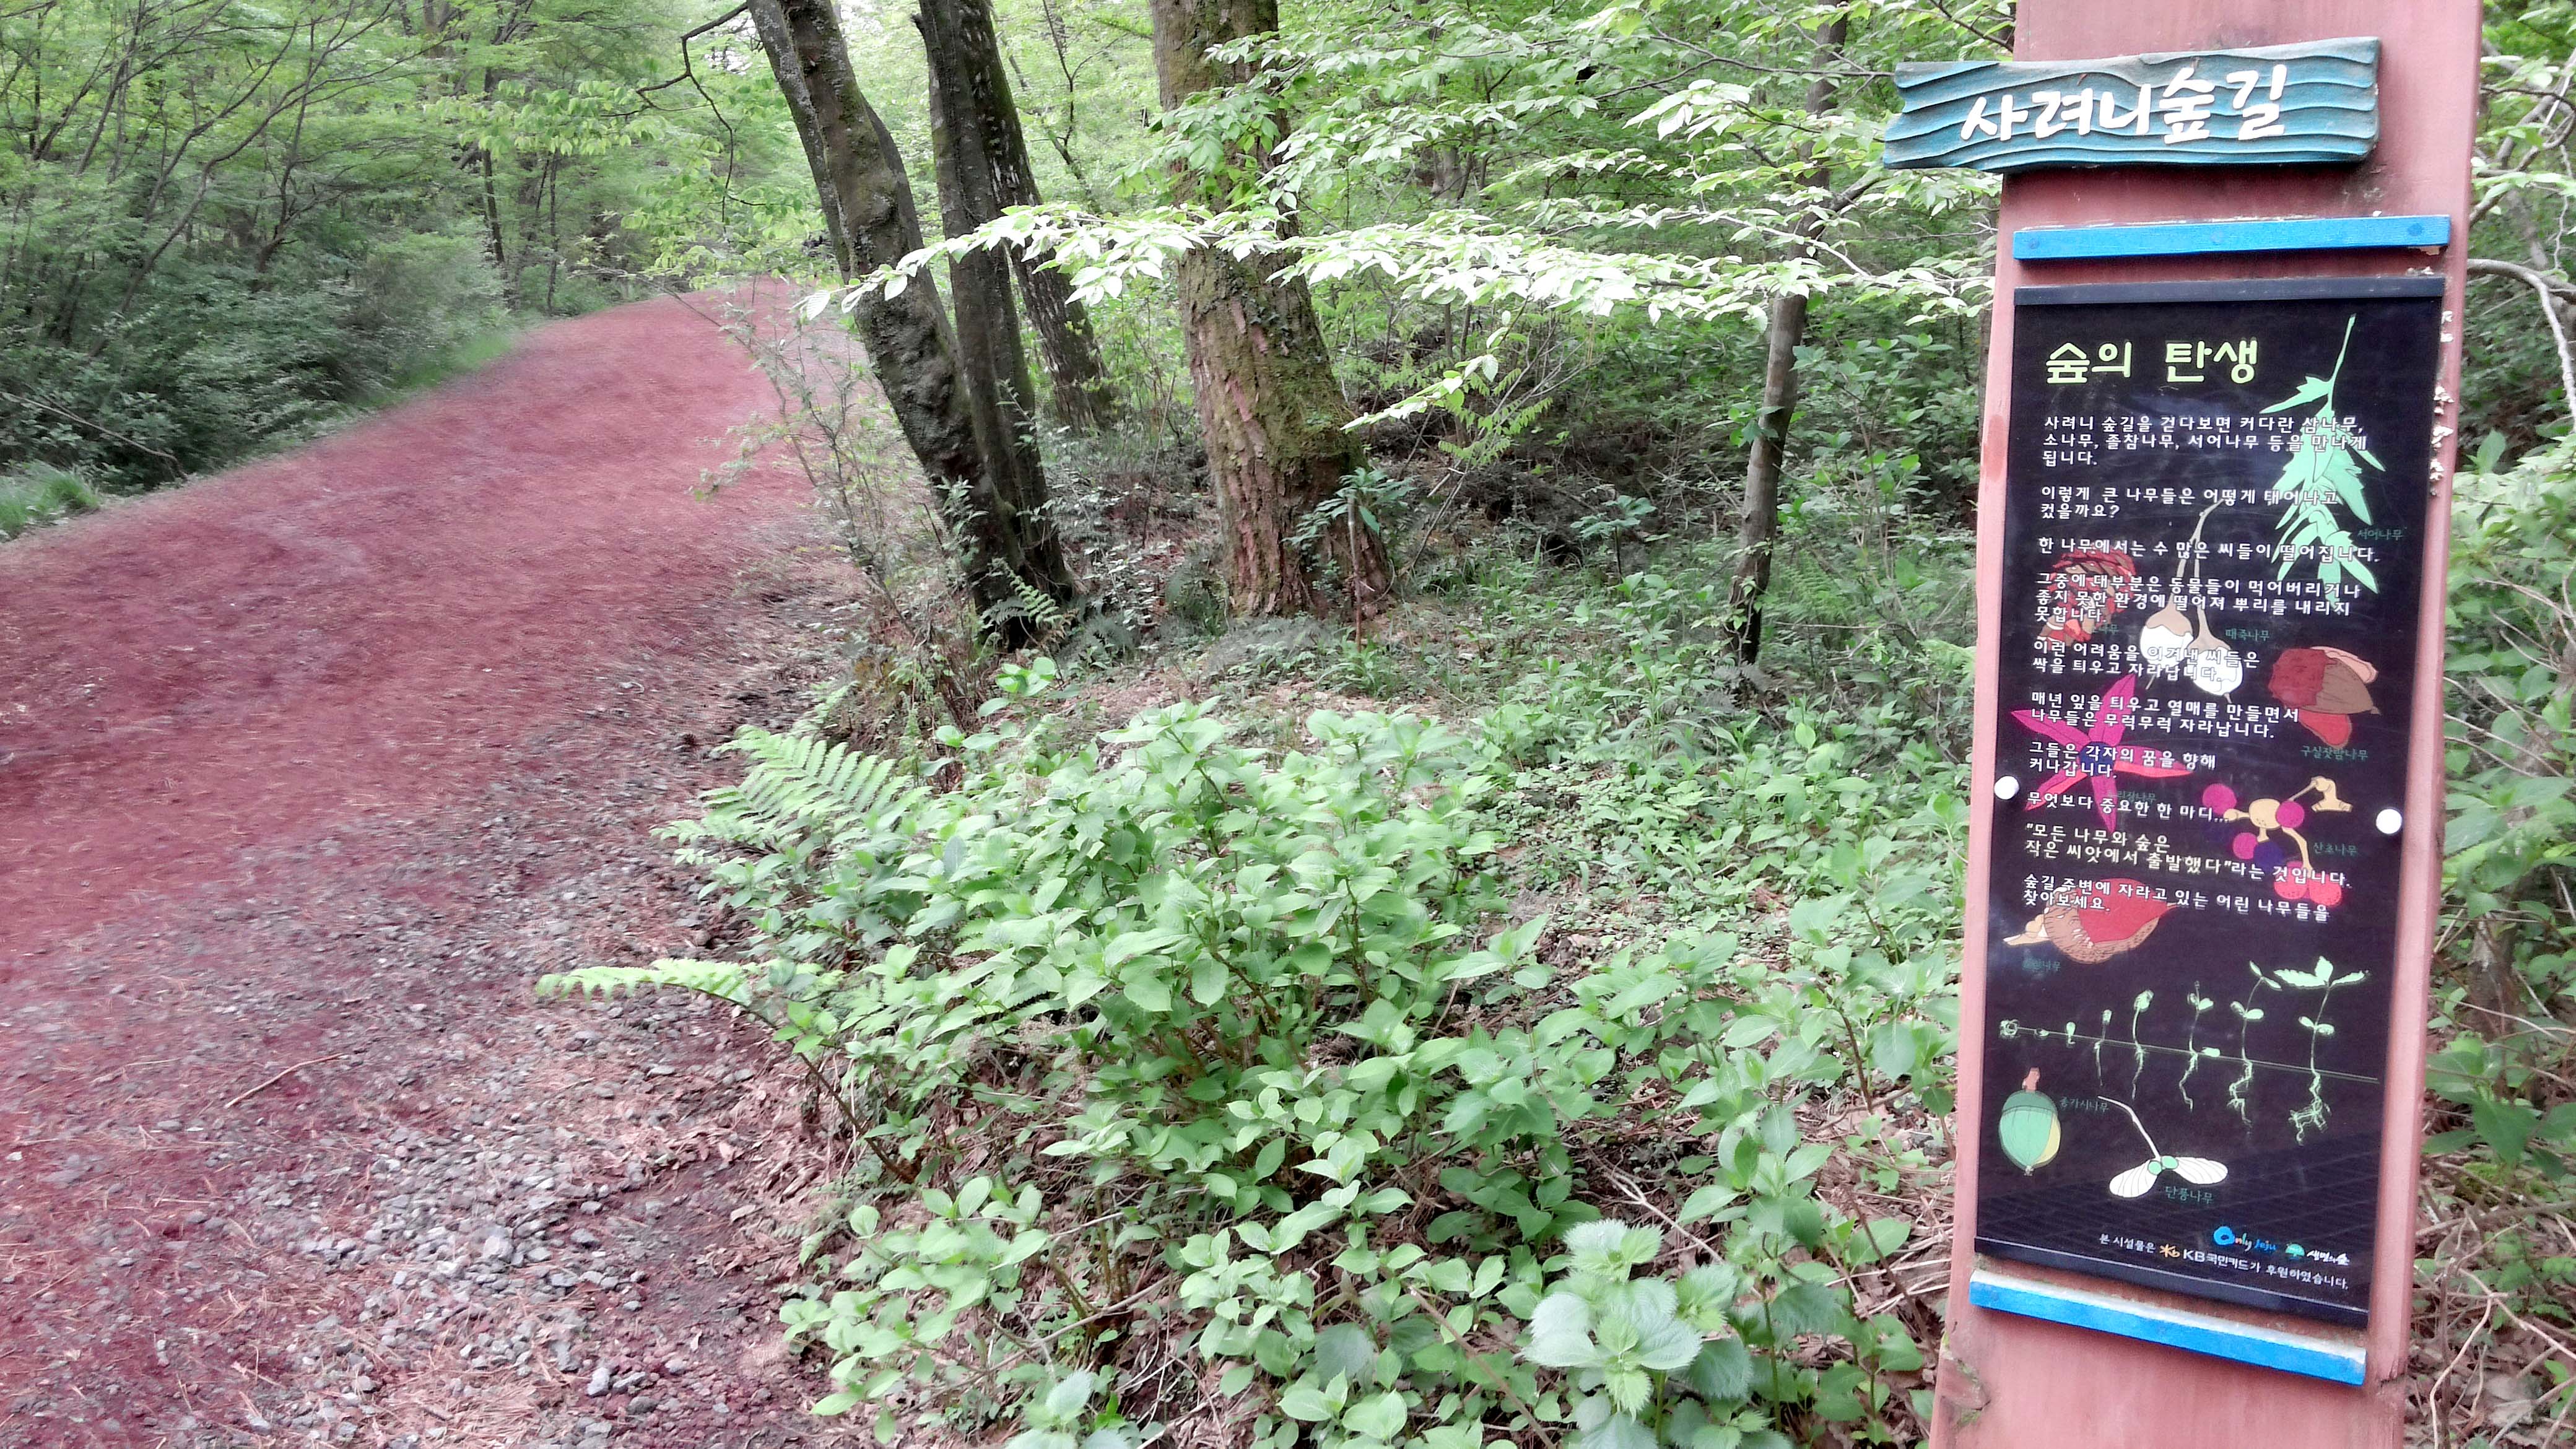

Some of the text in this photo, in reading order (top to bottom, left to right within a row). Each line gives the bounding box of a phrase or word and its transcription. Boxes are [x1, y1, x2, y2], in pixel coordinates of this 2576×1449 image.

[1960, 64, 2288, 145] 사려니숲길
[2045, 339, 2258, 384] 숲의 탄생
[2044, 416, 2364, 434] 사려니 숲길을 걷다보면 커다란 삼나무,
[2043, 433, 2367, 453] 소나무, 졸참나무, 서어나무 등을 만나게
[2042, 450, 2098, 467] 됩니다.
[2041, 486, 2338, 506] 이렇게 큰 나무들은 어떻게 태어나고
[2041, 503, 2120, 520] 컸을까요?
[2357, 528, 2404, 541] 서어나무
[2039, 537, 2380, 564] 한 나무에서는 수 많은 씨들이 떨어집니다.
[2035, 573, 2361, 599] 그중에 대부분은 동물들이 먹어버리거나
[2034, 606, 2106, 623] 못합니다.
[2035, 589, 2351, 617] 좋지 못한 환경에 떨어져 뿌리를 내리지
[2033, 640, 2261, 669] 이런 어려움을 이겨낸 씨들은
[2032, 658, 2222, 682] 싹을 틔우고 자라납니다.
[2031, 692, 2300, 723] 매년 잎을 틔우고 열매를 만들면서
[2031, 708, 2274, 739] 나무들은 무럭무럭 자라납니다.
[2029, 741, 2217, 770] 그들은 각자의 꿈을 향해
[2029, 758, 2118, 778] 커나갑니다.
[2027, 791, 2094, 809] 무엇보다
[2100, 798, 2150, 817] 중요한
[2157, 802, 2172, 820] 한
[2074, 827, 2129, 846] 나무와
[2135, 833, 2170, 853] 숲은
[2026, 839, 2060, 859] 작은
[2066, 842, 2139, 866] 씨앗에서
[2272, 866, 2351, 888] 것입니다.
[2024, 872, 2331, 922] 숲길 주변에 자라고 있는 어린 나무들을
[2024, 889, 2111, 912] 찾아보세요.
[2164, 1185, 2215, 1204] 단풍나무
